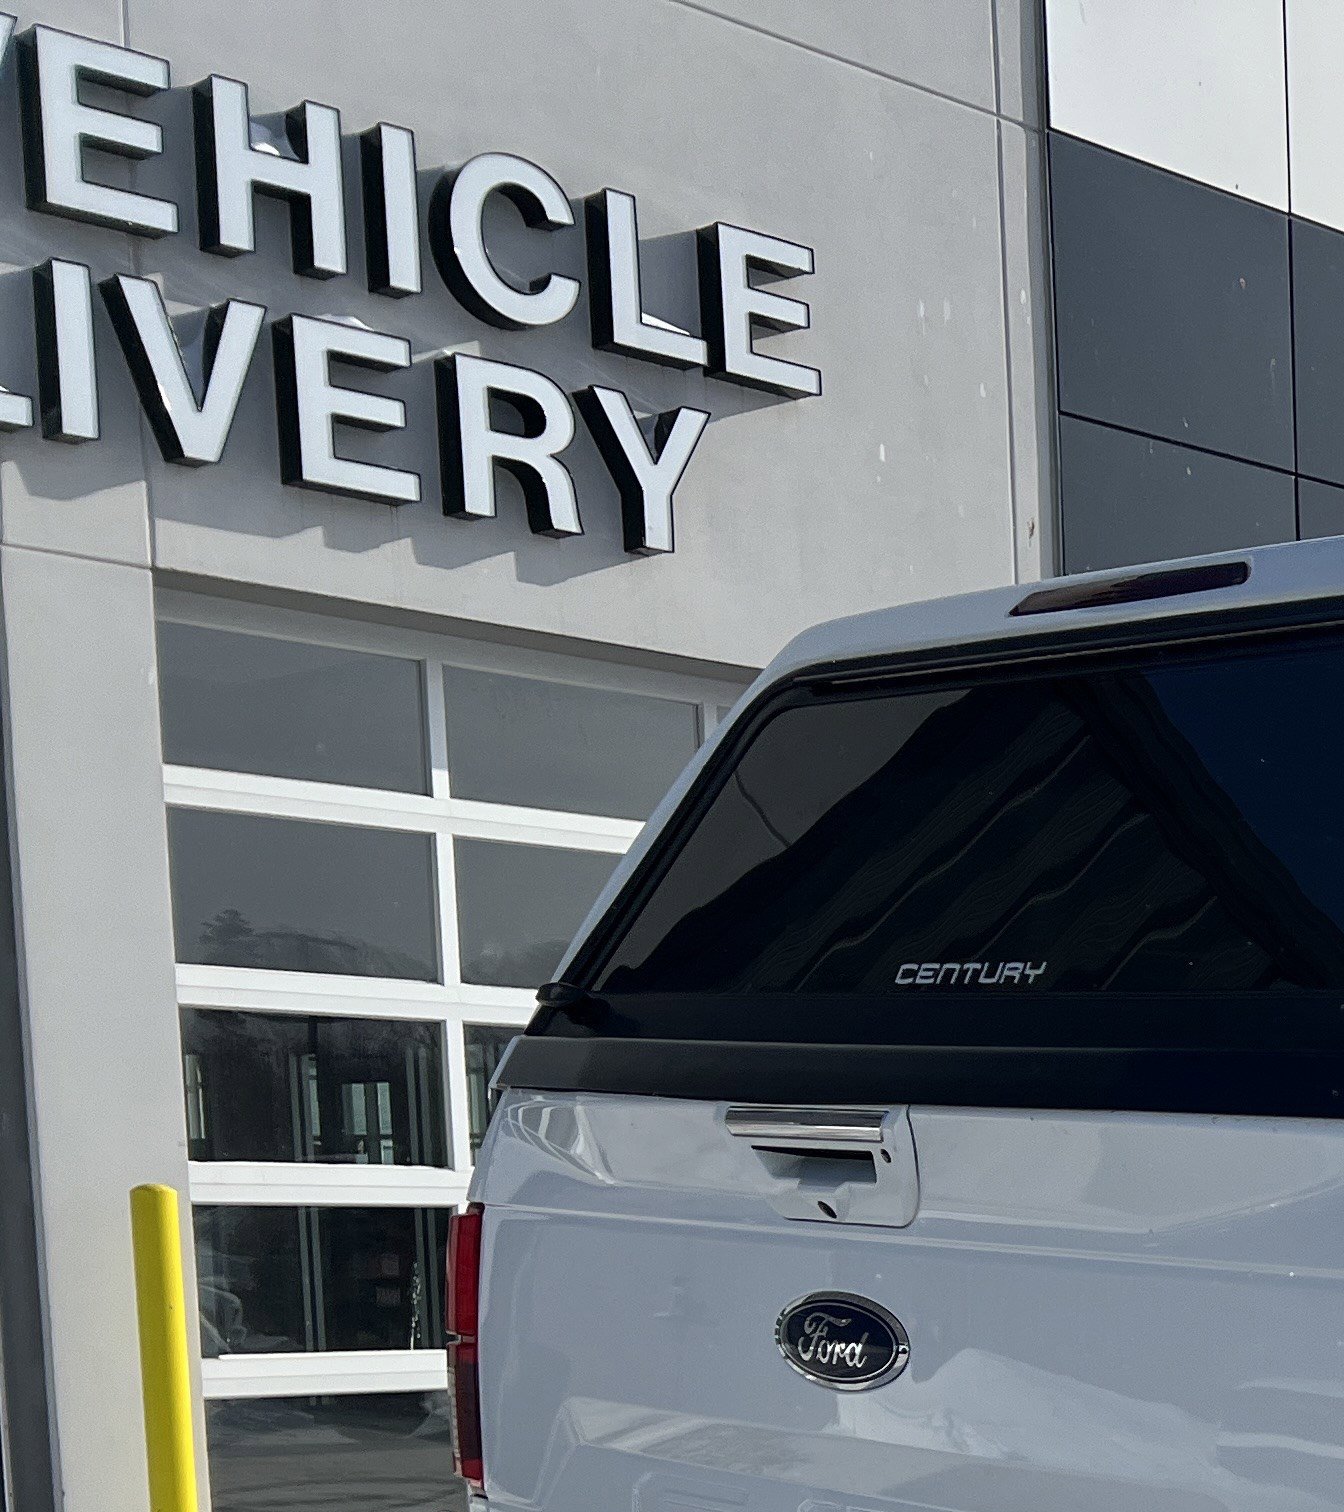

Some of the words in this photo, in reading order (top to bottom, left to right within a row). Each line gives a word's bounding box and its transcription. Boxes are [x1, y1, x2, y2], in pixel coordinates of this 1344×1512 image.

[0, 14, 822, 397] EHICLE
[0, 258, 710, 556] IVERY
[895, 961, 1047, 984] CENTURY
[797, 1312, 868, 1369] Ford
